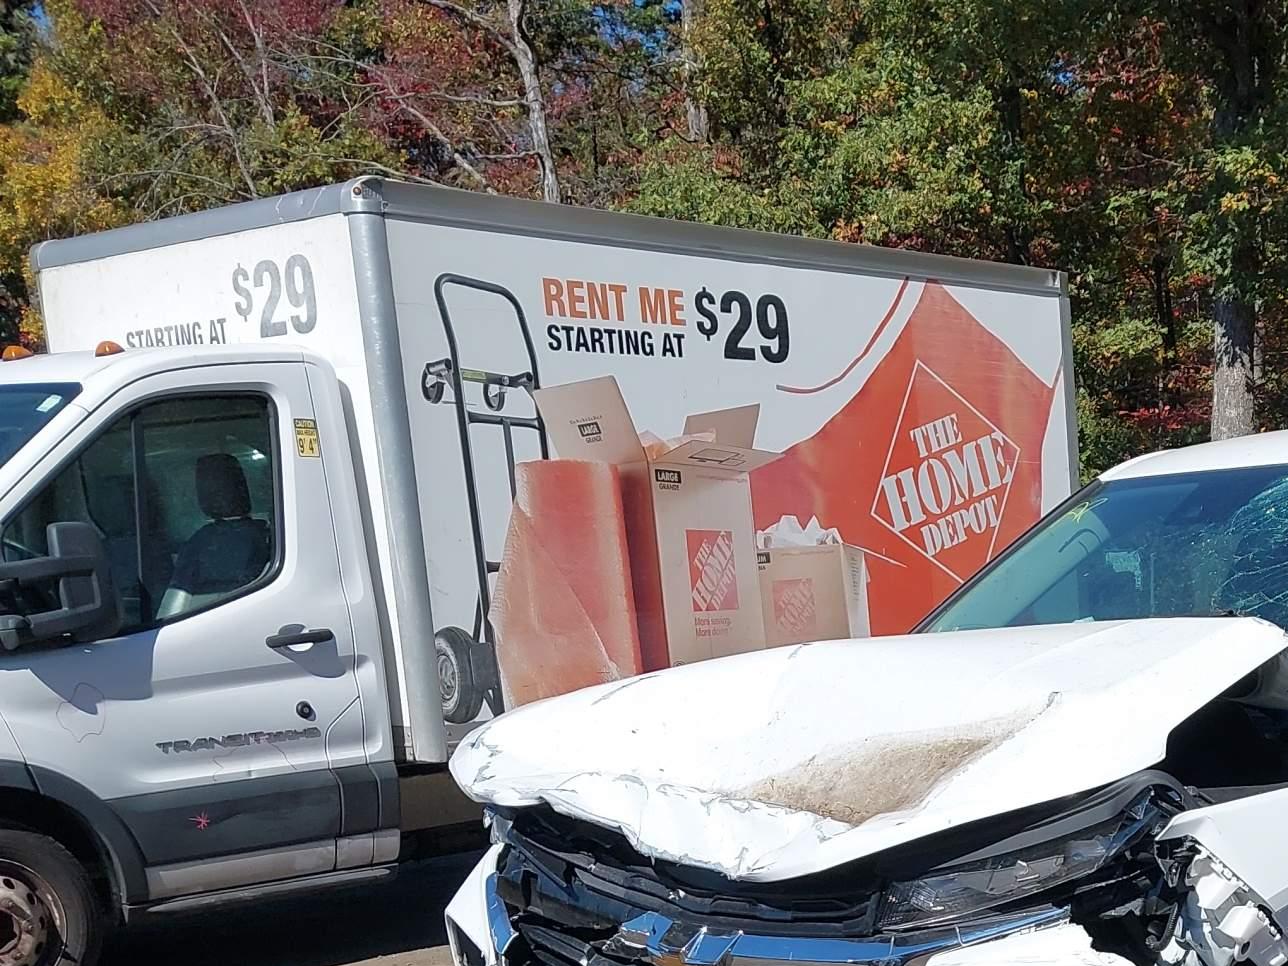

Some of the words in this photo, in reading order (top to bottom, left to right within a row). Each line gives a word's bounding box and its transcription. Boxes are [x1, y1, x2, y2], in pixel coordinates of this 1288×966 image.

[232, 253, 318, 339] $29
[542, 277, 628, 322] RENT
[638, 286, 687, 326] ME
[126, 321, 204, 348] STARTING
[209, 318, 227, 345] AT
[546, 324, 655, 357] STARTING
[661, 333, 686, 358] AT
[694, 286, 790, 364] $29
[909, 413, 963, 459] THE
[656, 470, 680, 482] LARGE
[881, 431, 1013, 533] HOME
[920, 495, 998, 557] DEPOT
[155, 731, 265, 755] TRANSIT
